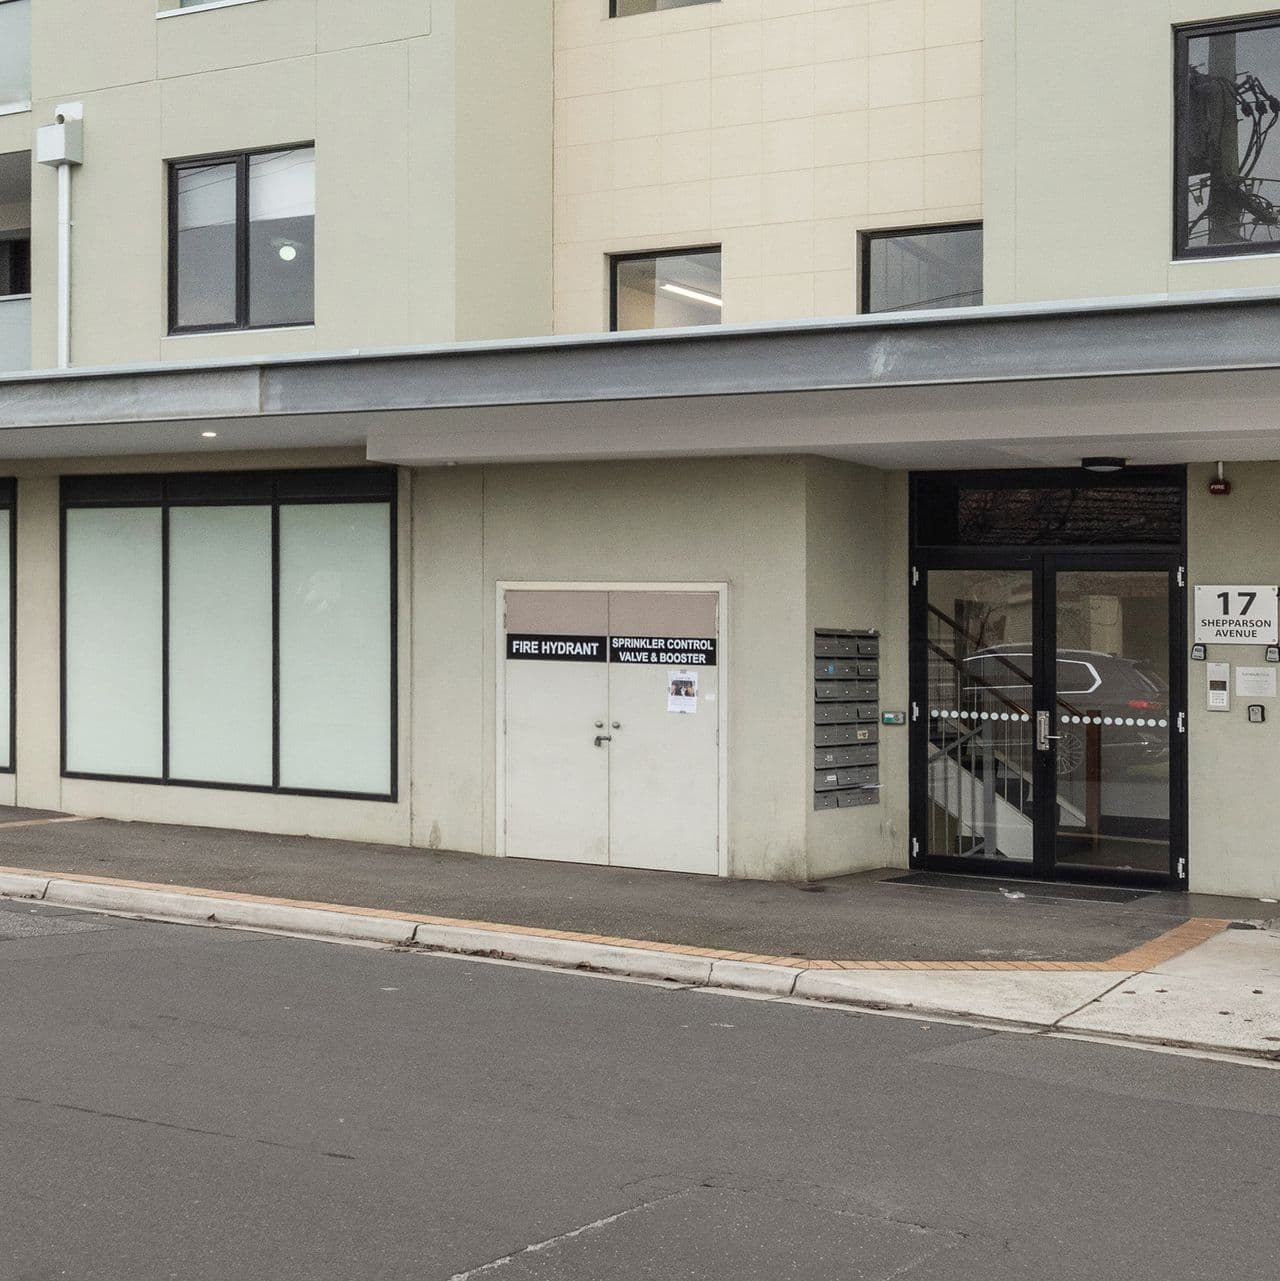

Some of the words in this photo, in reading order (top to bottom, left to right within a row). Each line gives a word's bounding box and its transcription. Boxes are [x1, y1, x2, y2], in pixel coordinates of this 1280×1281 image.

[1217, 591, 1257, 616] 17
[1201, 618, 1272, 628] SHEPPARSON
[1215, 629, 1257, 638] AVENUE
[512, 640, 539, 654] FIRE
[541, 641, 600, 656] HYDRANT
[612, 638, 666, 650] SPRINKLER
[666, 639, 714, 651] CONTROL
[619, 651, 650, 663] VALVE
[650, 652, 658, 663] &
[659, 652, 706, 664] BOOSTER
